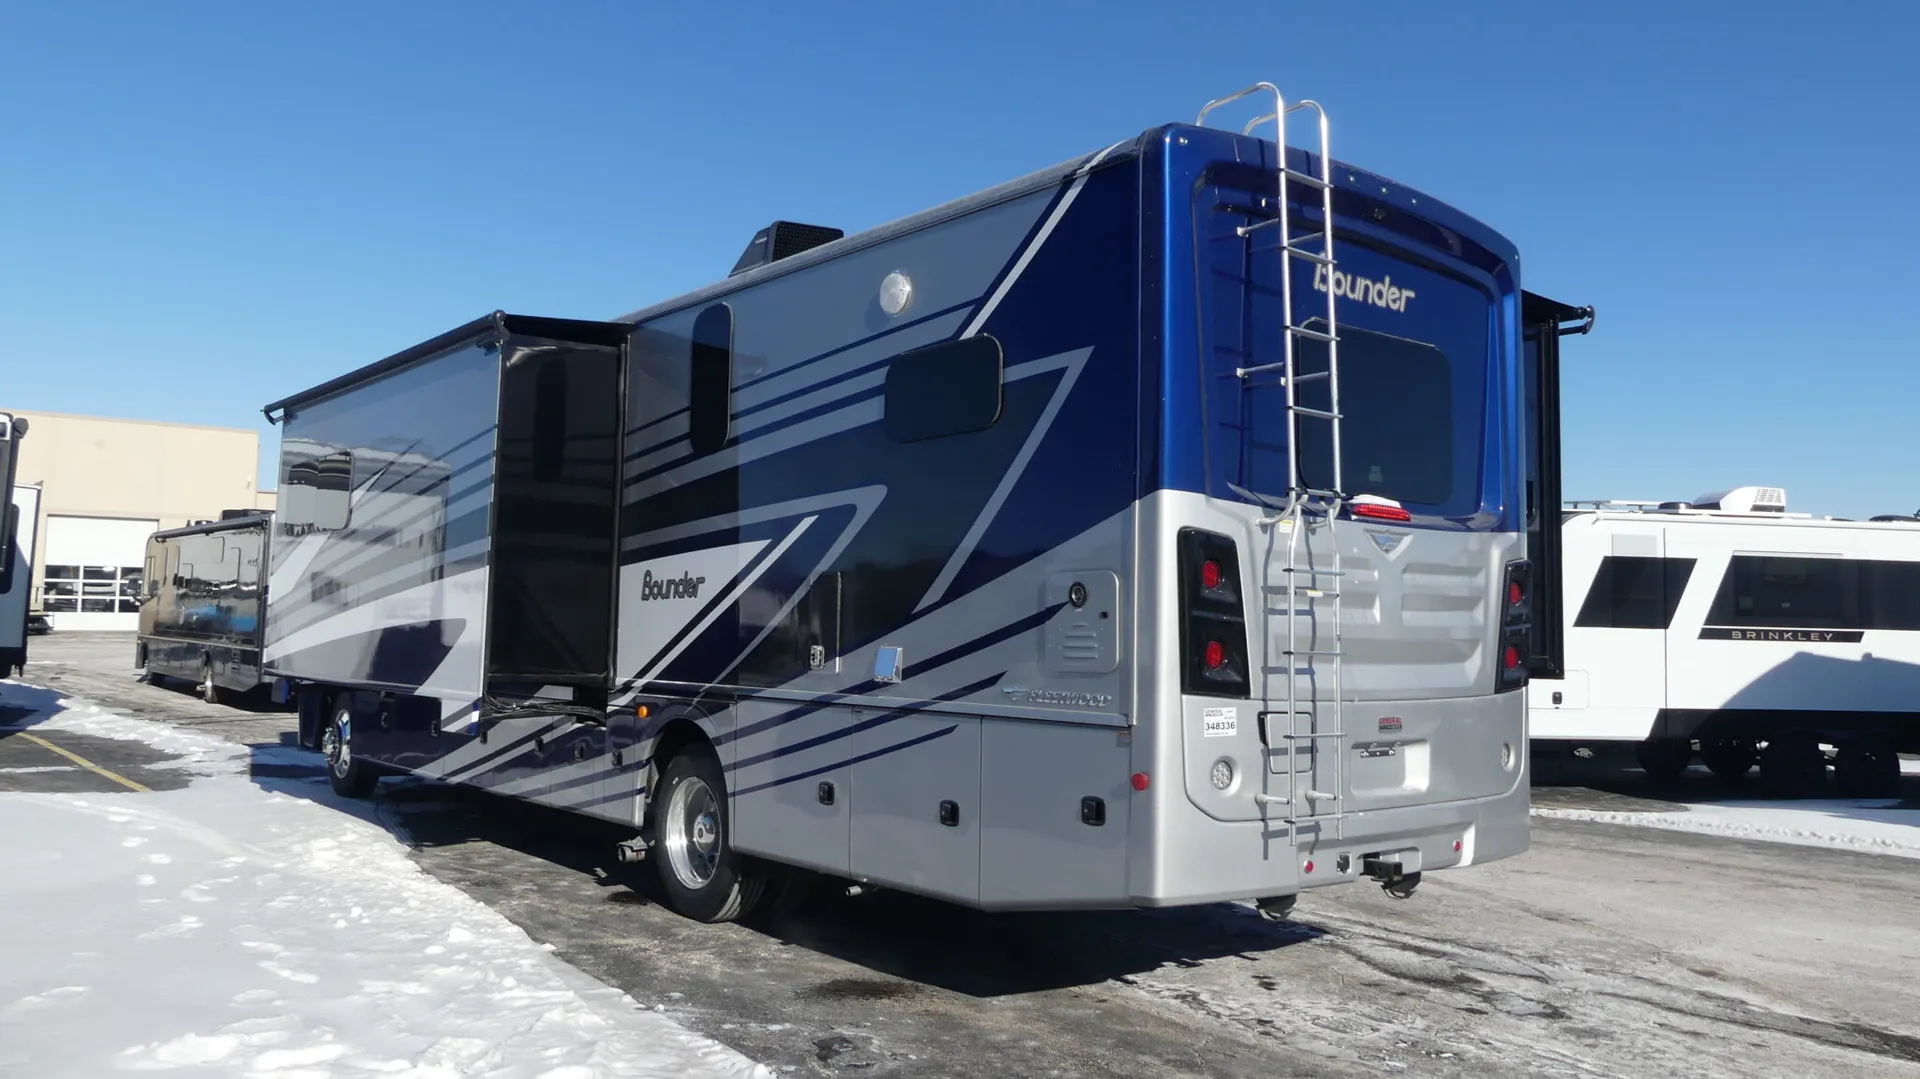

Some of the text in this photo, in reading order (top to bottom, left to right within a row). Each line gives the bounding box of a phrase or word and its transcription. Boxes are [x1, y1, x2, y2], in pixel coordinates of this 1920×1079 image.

[641, 569, 705, 601] Bounder
[1732, 630, 1833, 641] BRINKLEY
[1205, 721, 1236, 731] 348336
